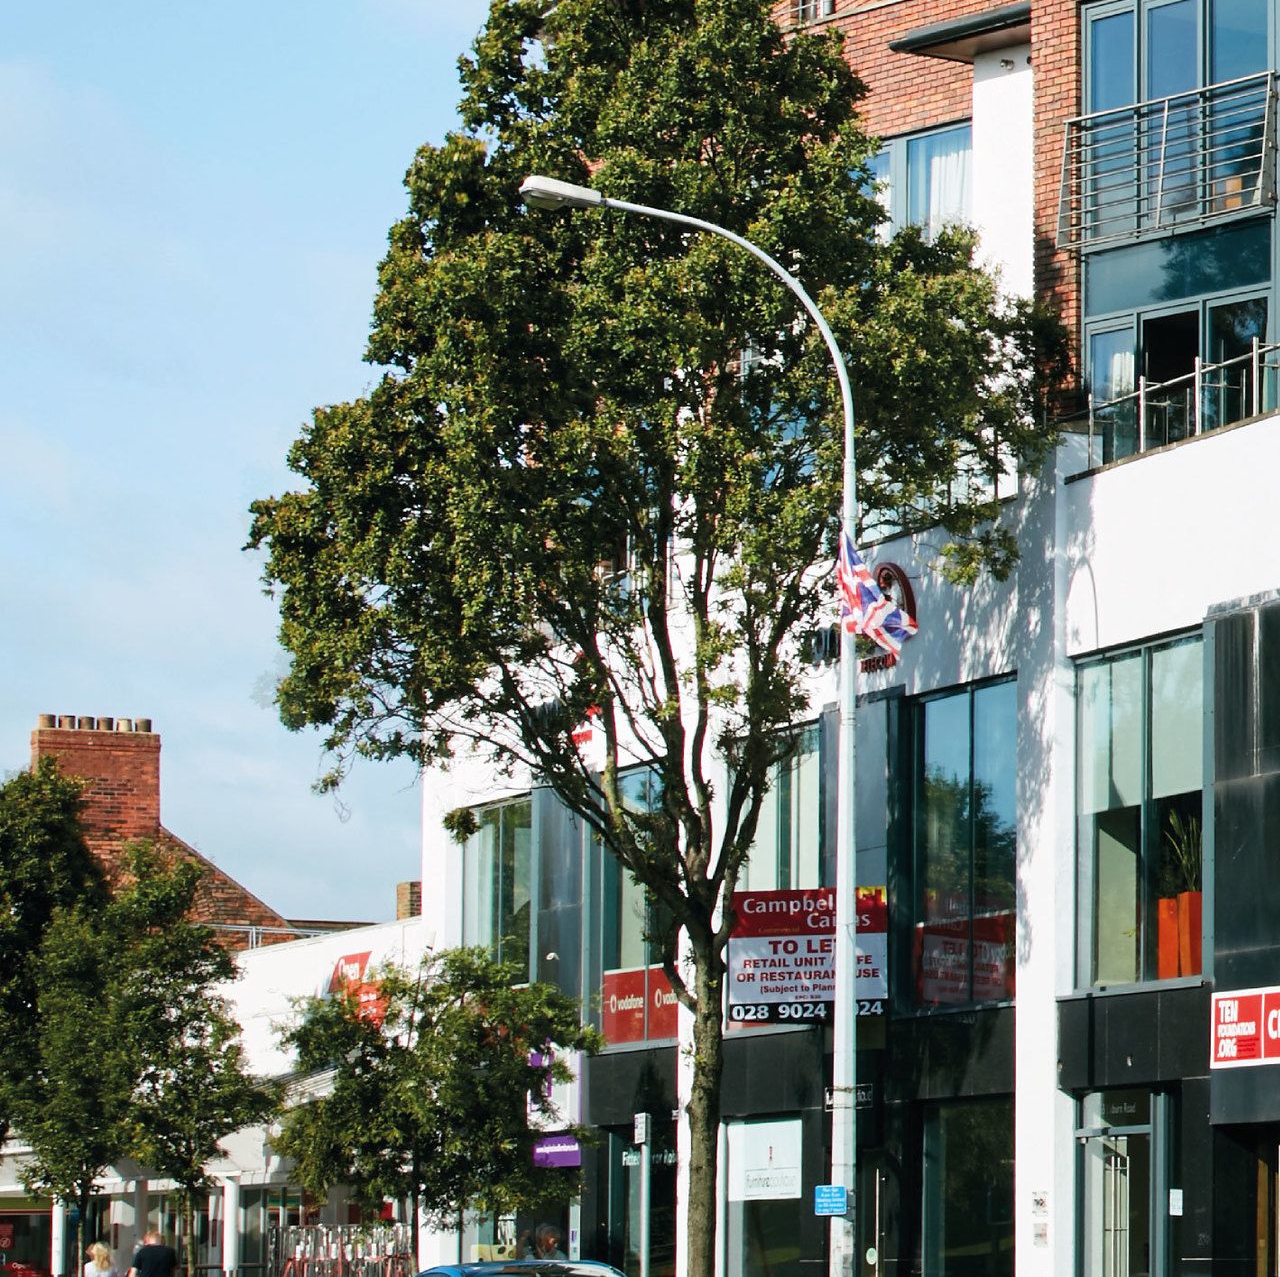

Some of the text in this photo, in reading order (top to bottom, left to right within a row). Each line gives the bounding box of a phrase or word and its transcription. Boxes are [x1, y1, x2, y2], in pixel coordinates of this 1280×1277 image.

[768, 939, 798, 955] TO
[743, 957, 790, 969] RETAIL
[794, 956, 826, 967] UNIT
[736, 972, 755, 983] OR
[618, 993, 644, 1011] vodafone
[732, 1005, 769, 1020] 028
[778, 1003, 827, 1019] 9024
[1218, 1000, 1238, 1023] TEN
[1217, 1038, 1237, 1058] .ORG
